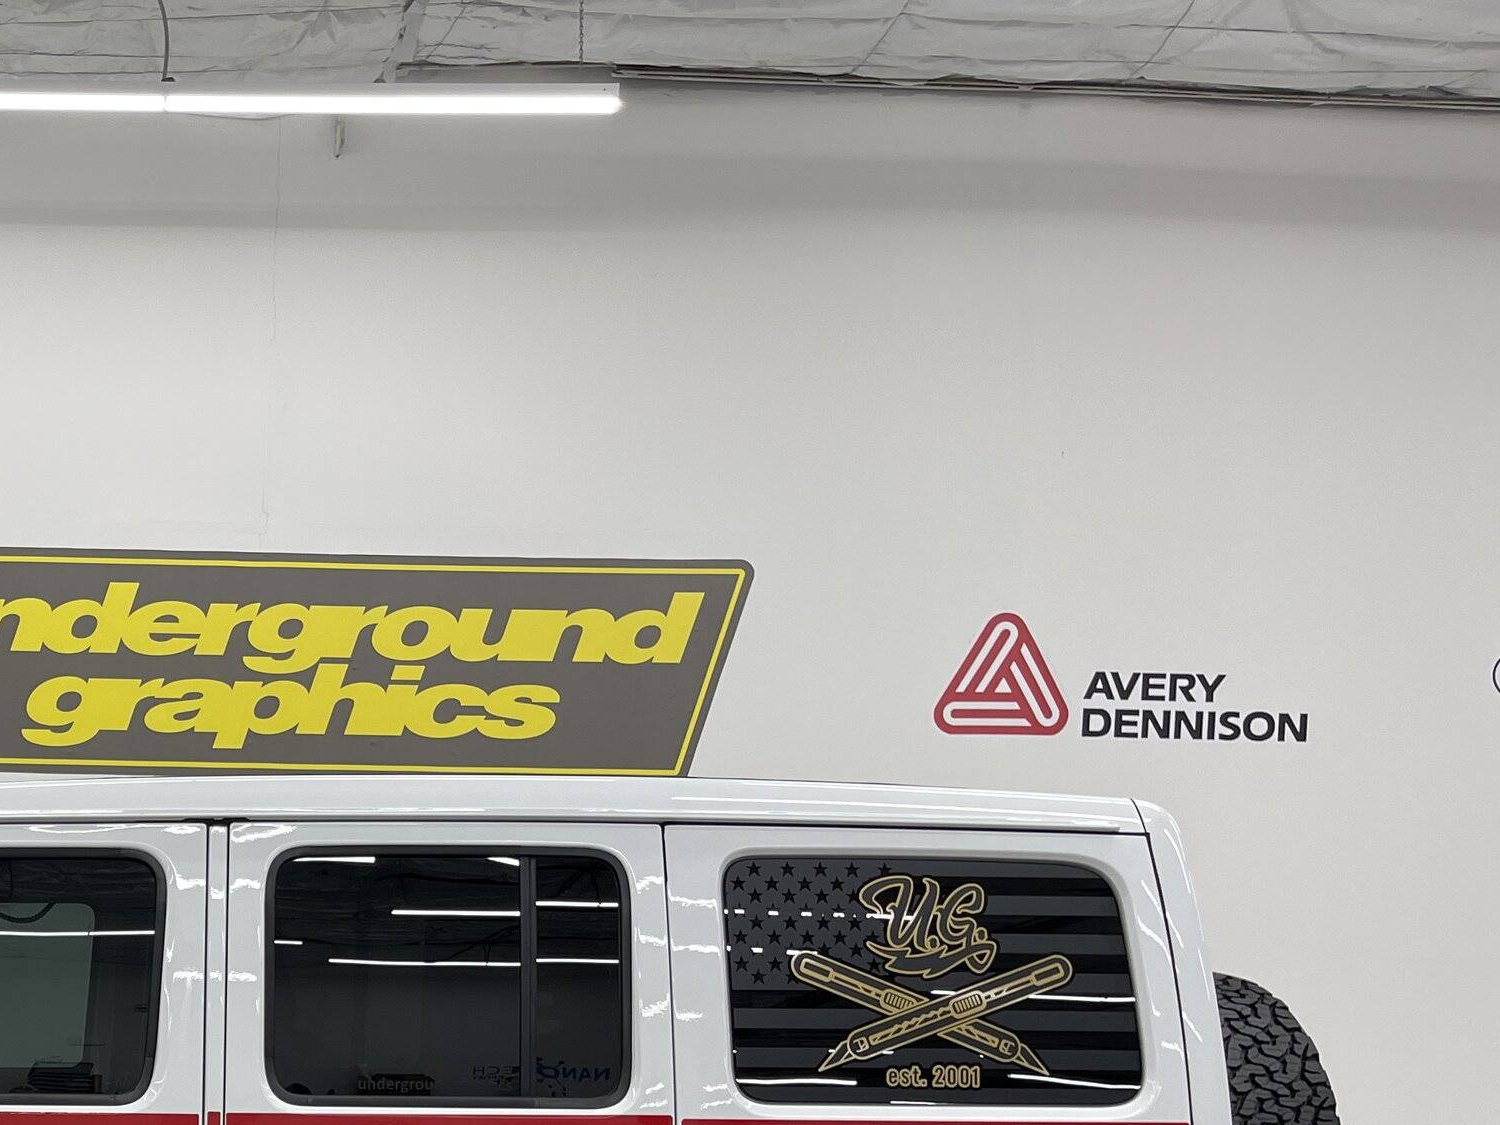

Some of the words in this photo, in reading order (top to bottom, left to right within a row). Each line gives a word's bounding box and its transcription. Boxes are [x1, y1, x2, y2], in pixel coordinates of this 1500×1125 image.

[1083, 671, 1227, 702] AVERY
[21, 664, 561, 749] graphics
[1081, 708, 1309, 742] DENNISON
[886, 1064, 928, 1088] est.
[932, 1064, 981, 1088] 2001
